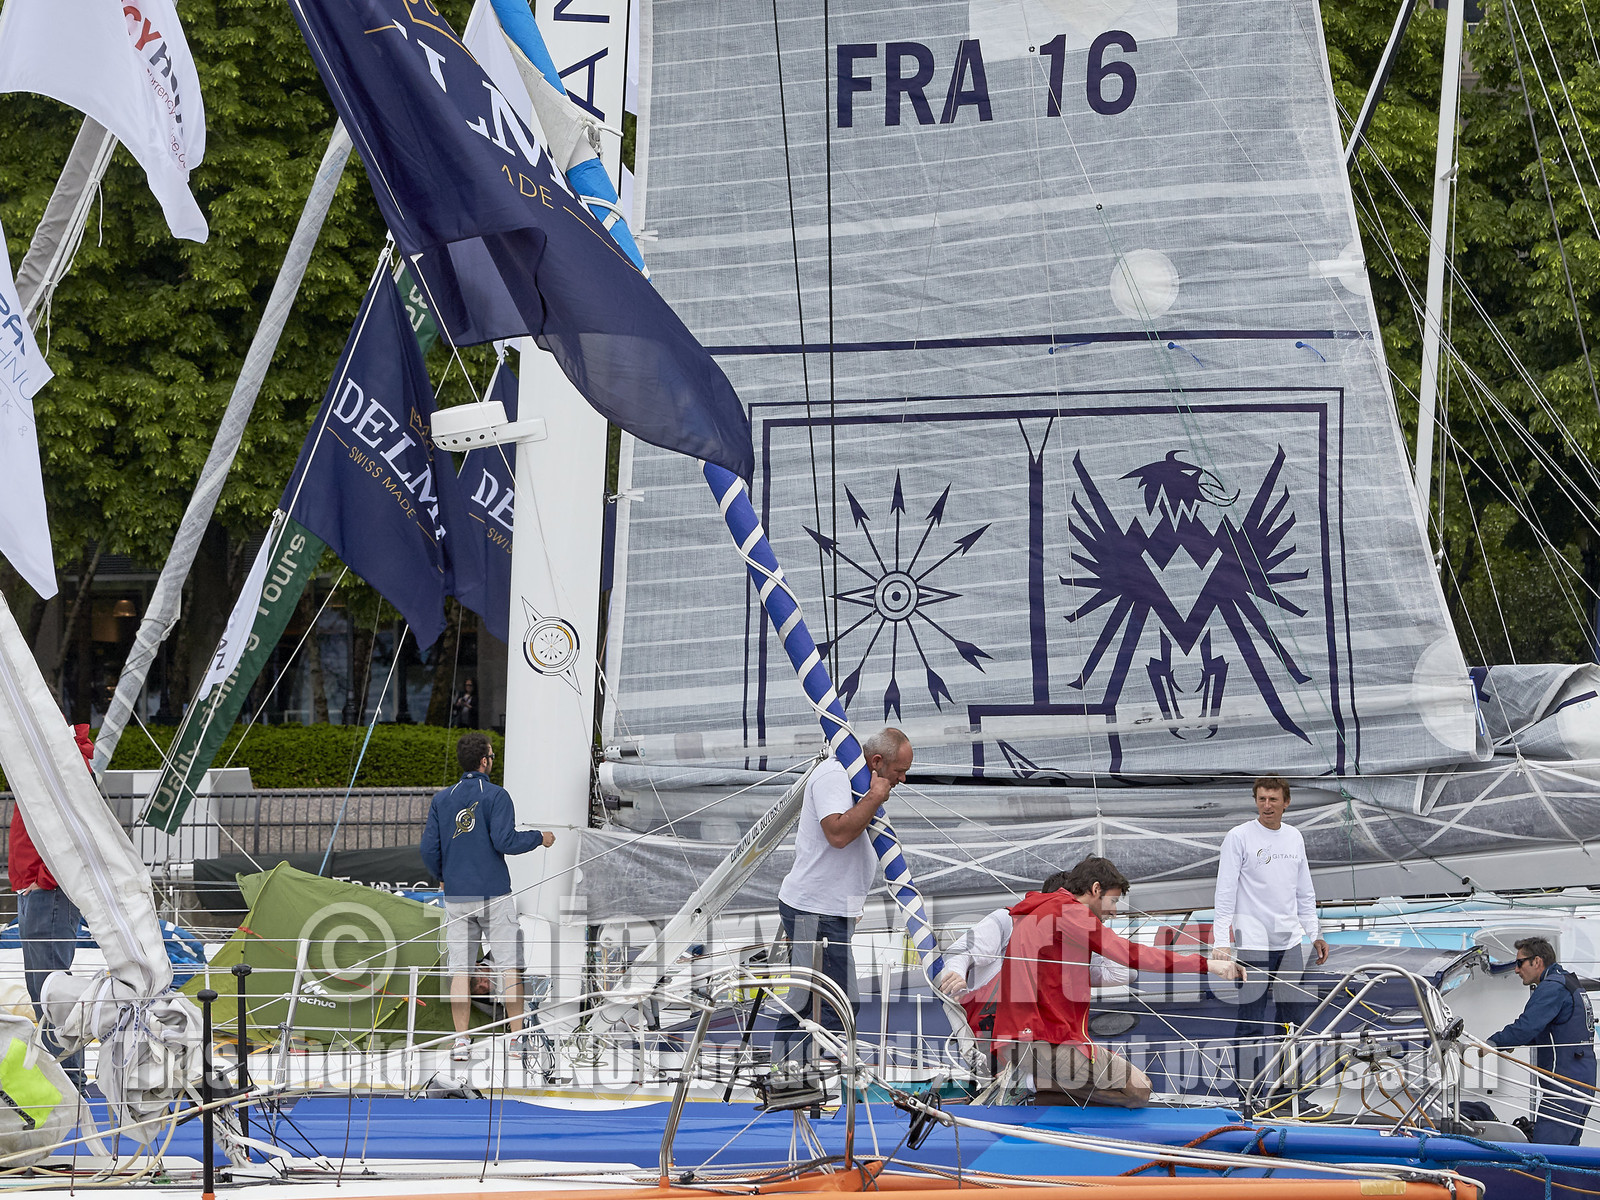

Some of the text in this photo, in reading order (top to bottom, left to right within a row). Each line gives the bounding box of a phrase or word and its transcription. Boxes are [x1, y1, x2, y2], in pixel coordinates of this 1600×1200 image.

[836, 29, 1139, 128] FRA 16
[349, 446, 417, 519] SWISS MADE
